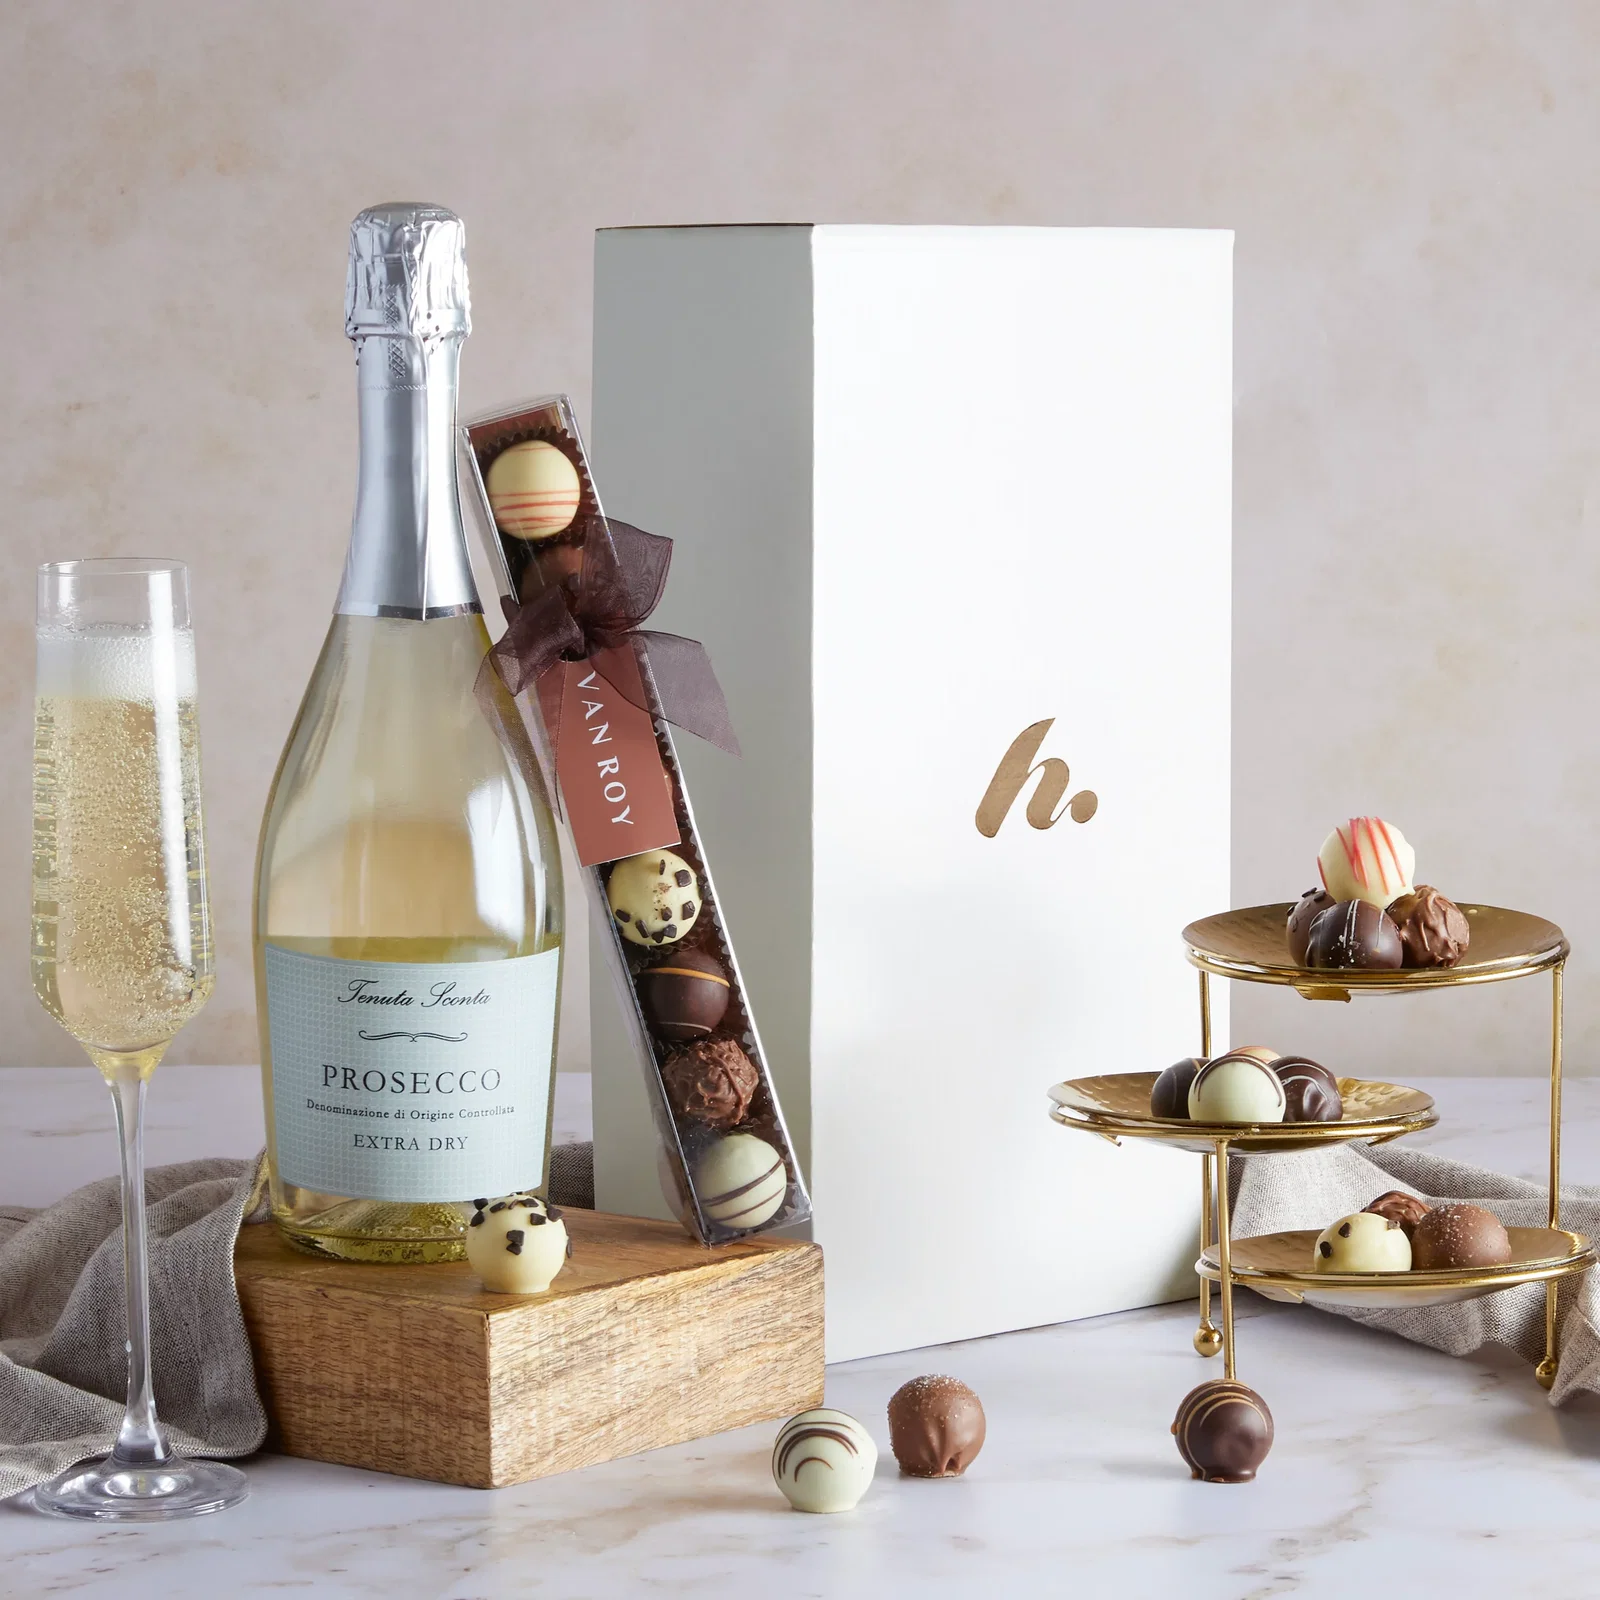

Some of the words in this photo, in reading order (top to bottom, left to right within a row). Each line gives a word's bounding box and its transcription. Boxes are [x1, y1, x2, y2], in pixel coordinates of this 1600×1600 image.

[577, 671, 613, 745] VAN
[597, 756, 634, 825] ROY
[337, 978, 415, 1007] Tenuta
[421, 981, 492, 1008] Sconta
[322, 1064, 501, 1095] PROSECCO
[306, 1098, 390, 1119] Denominazione
[394, 1109, 406, 1120] di
[410, 1109, 455, 1123] Origine
[458, 1105, 515, 1120] Controllata
[353, 1133, 420, 1151] EXTRA
[428, 1135, 469, 1151] DRY
